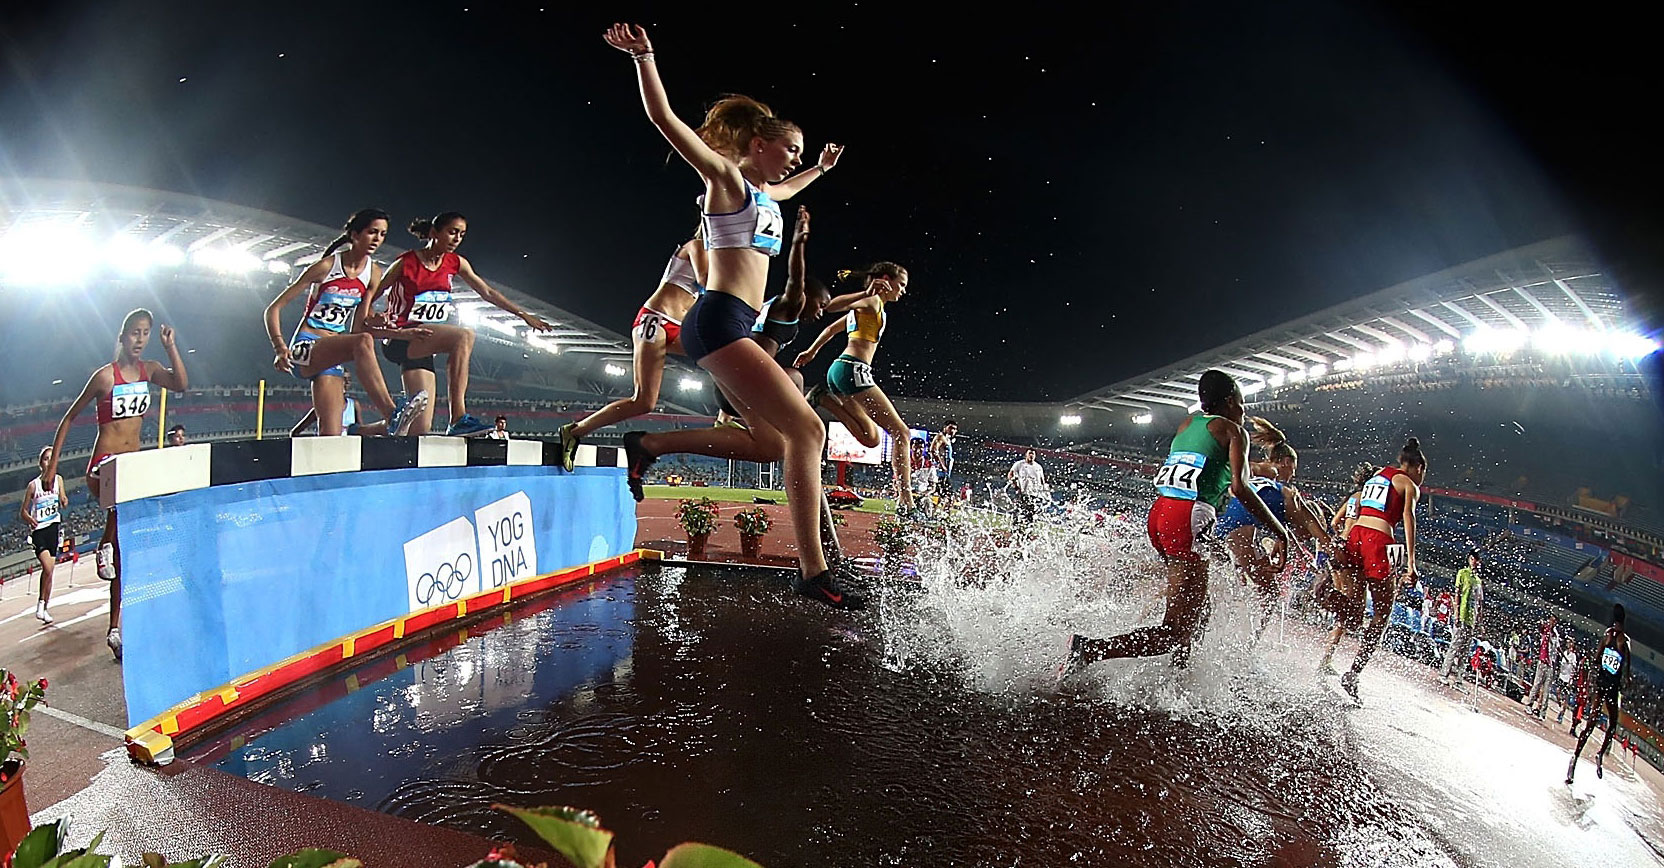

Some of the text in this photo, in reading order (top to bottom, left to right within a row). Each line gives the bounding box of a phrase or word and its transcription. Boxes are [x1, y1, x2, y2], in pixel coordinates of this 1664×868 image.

[413, 303, 446, 321] 406
[640, 315, 659, 340] 16
[115, 395, 148, 416] 346
[1155, 464, 1196, 489] 214
[40, 504, 57, 518] 105
[487, 511, 524, 552] YOG
[491, 546, 528, 588] DNA
[1603, 655, 1619, 670] 298
